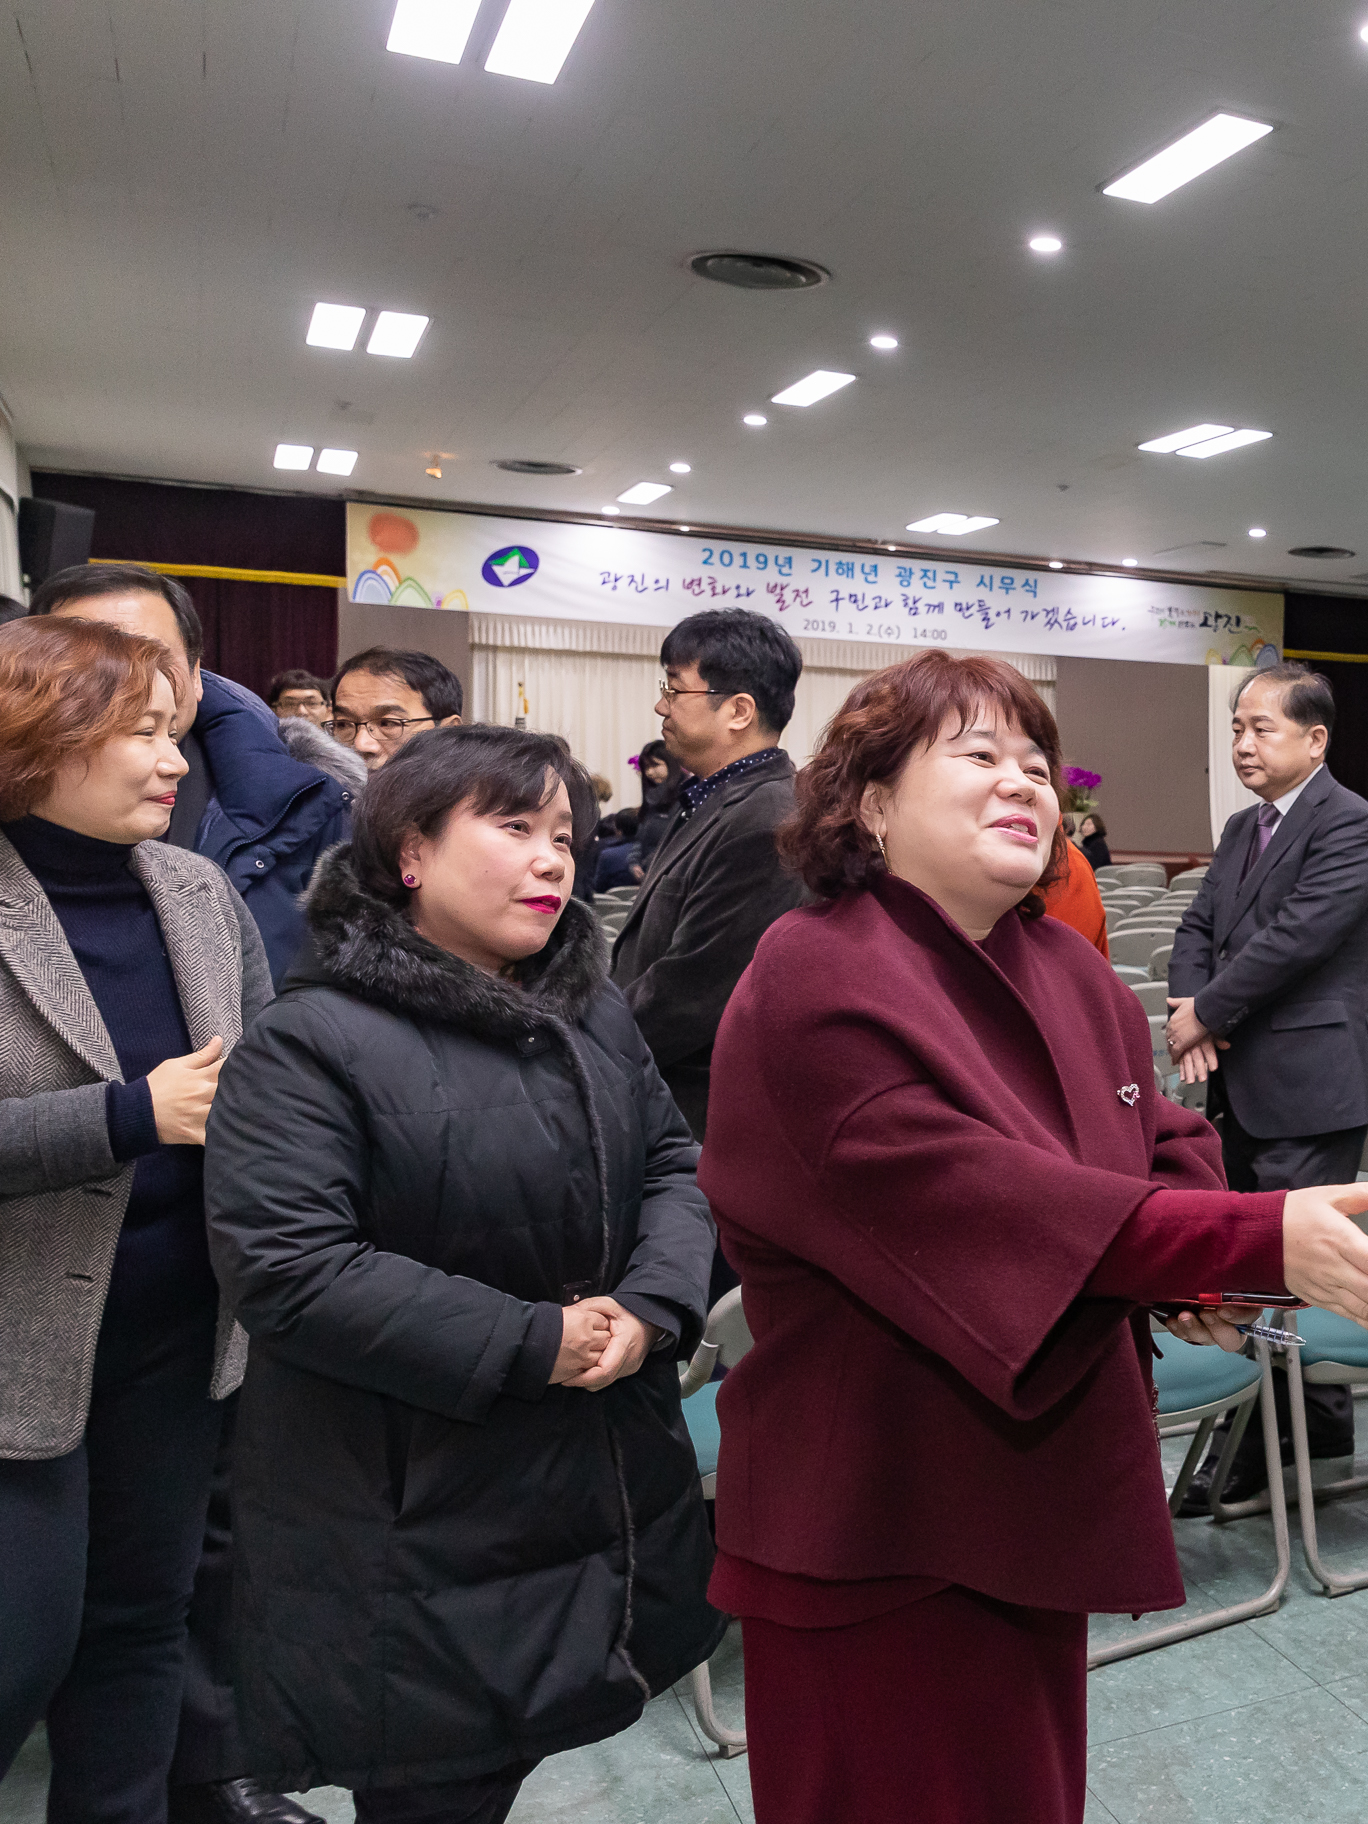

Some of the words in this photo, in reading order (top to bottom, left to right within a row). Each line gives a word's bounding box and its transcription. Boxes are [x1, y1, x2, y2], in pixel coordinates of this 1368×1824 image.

[701, 547, 793, 577] 2019년
[810, 558, 879, 584] 기해년
[895, 565, 961, 590] 광진구
[976, 574, 1039, 599] 시무식
[599, 570, 670, 594] 광진의
[682, 576, 756, 598] 변화와
[766, 581, 813, 612] 발전
[829, 588, 893, 613] 구민과
[900, 593, 945, 616] 함께
[953, 599, 1012, 630] 만들어
[1019, 605, 1126, 632] 가겠습니다.
[912, 627, 948, 641] 14:00
